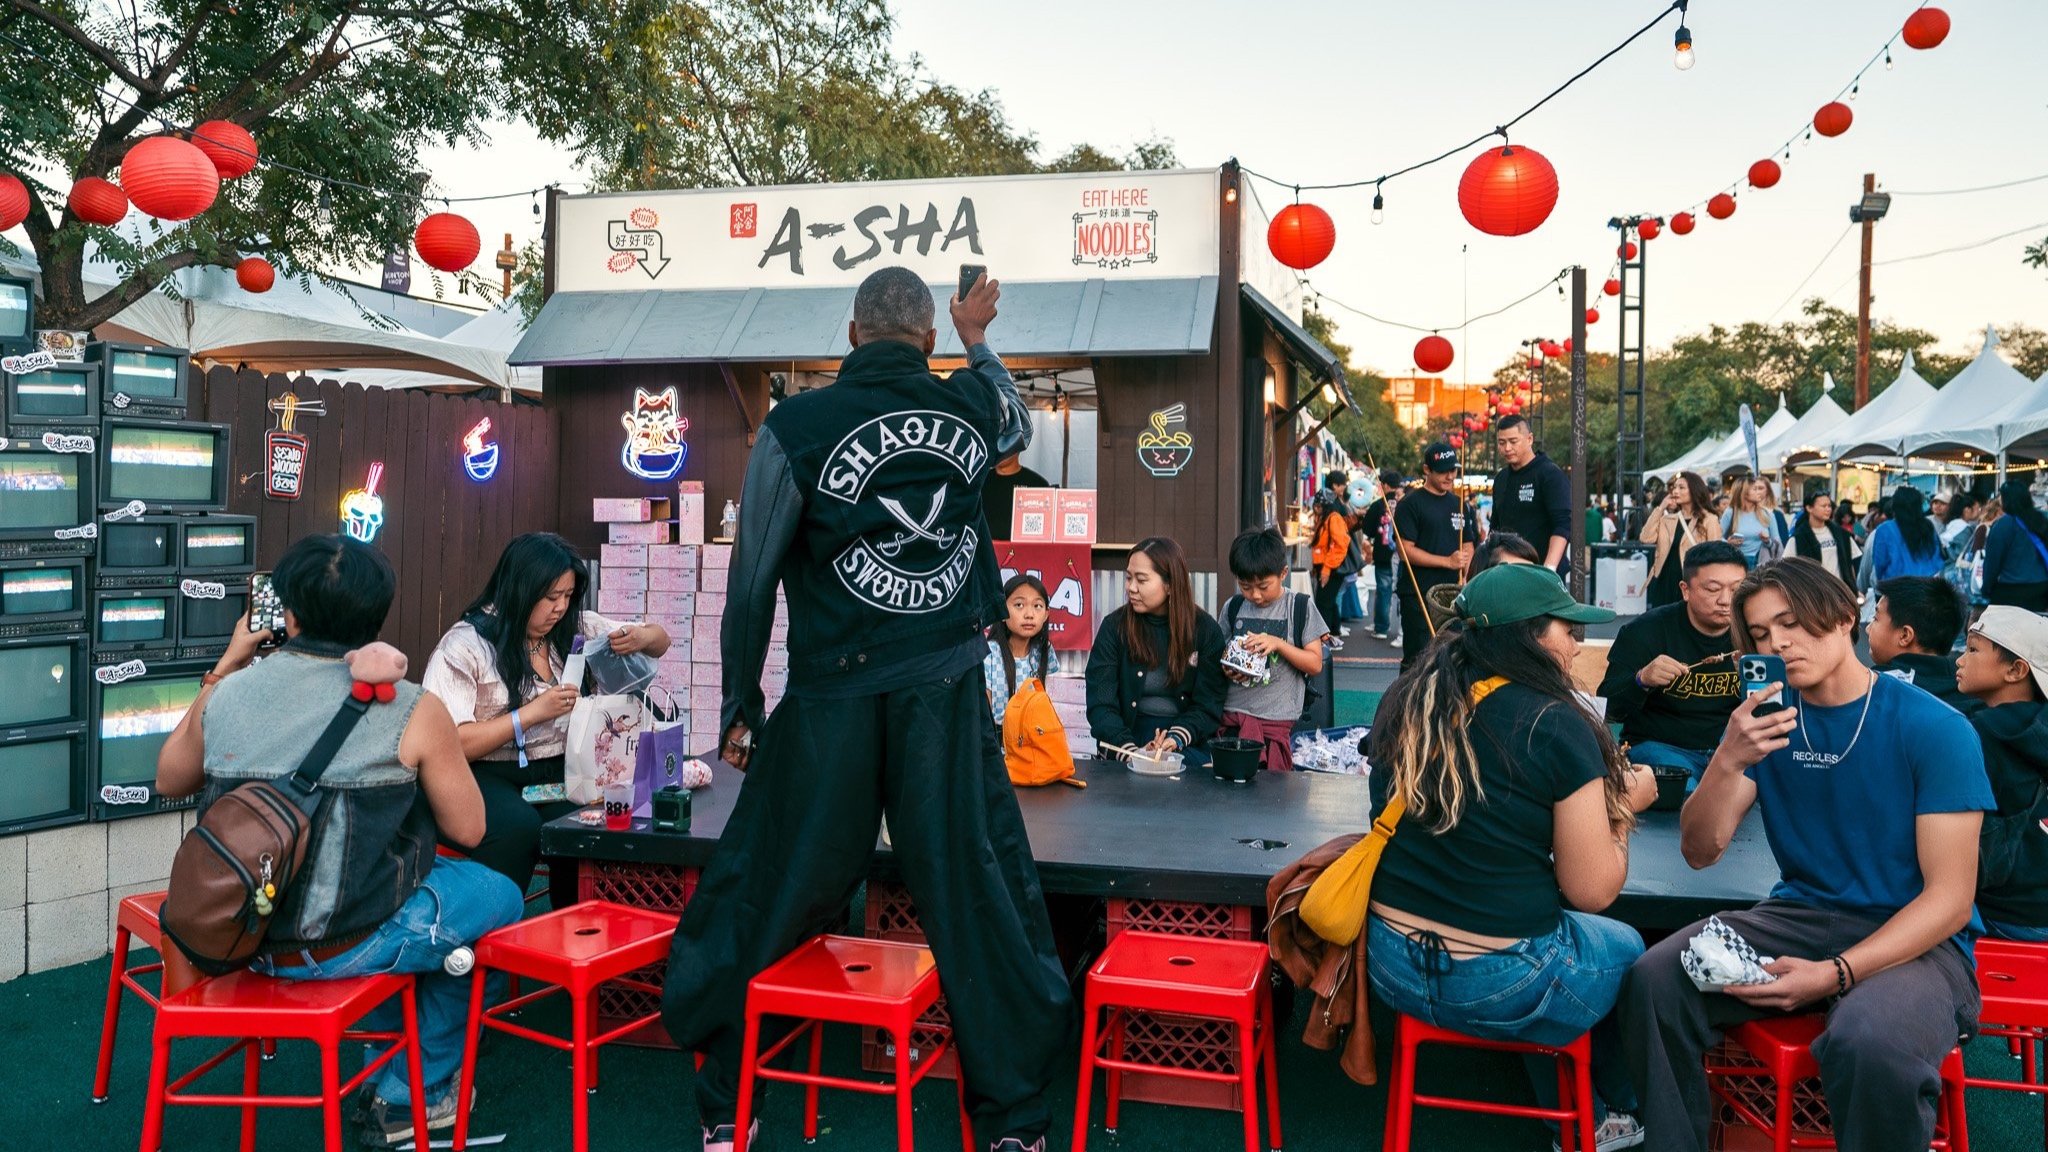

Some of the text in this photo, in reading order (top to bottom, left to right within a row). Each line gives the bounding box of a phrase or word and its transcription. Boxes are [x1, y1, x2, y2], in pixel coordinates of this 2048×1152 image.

[1082, 188, 1148, 207] EAT HERE
[615, 233, 655, 247] 好好吃
[758, 195, 985, 276] A-SHA
[1078, 221, 1151, 257] NOODLES
[13, 354, 53, 371] A-SHA
[51, 435, 92, 451] A-SHA
[828, 416, 985, 497] SHAOLIN
[842, 536, 976, 608] SWORDSMEN
[189, 583, 223, 597] A-SHA
[105, 663, 144, 681] A-SHA
[111, 788, 147, 801] A-SHA
